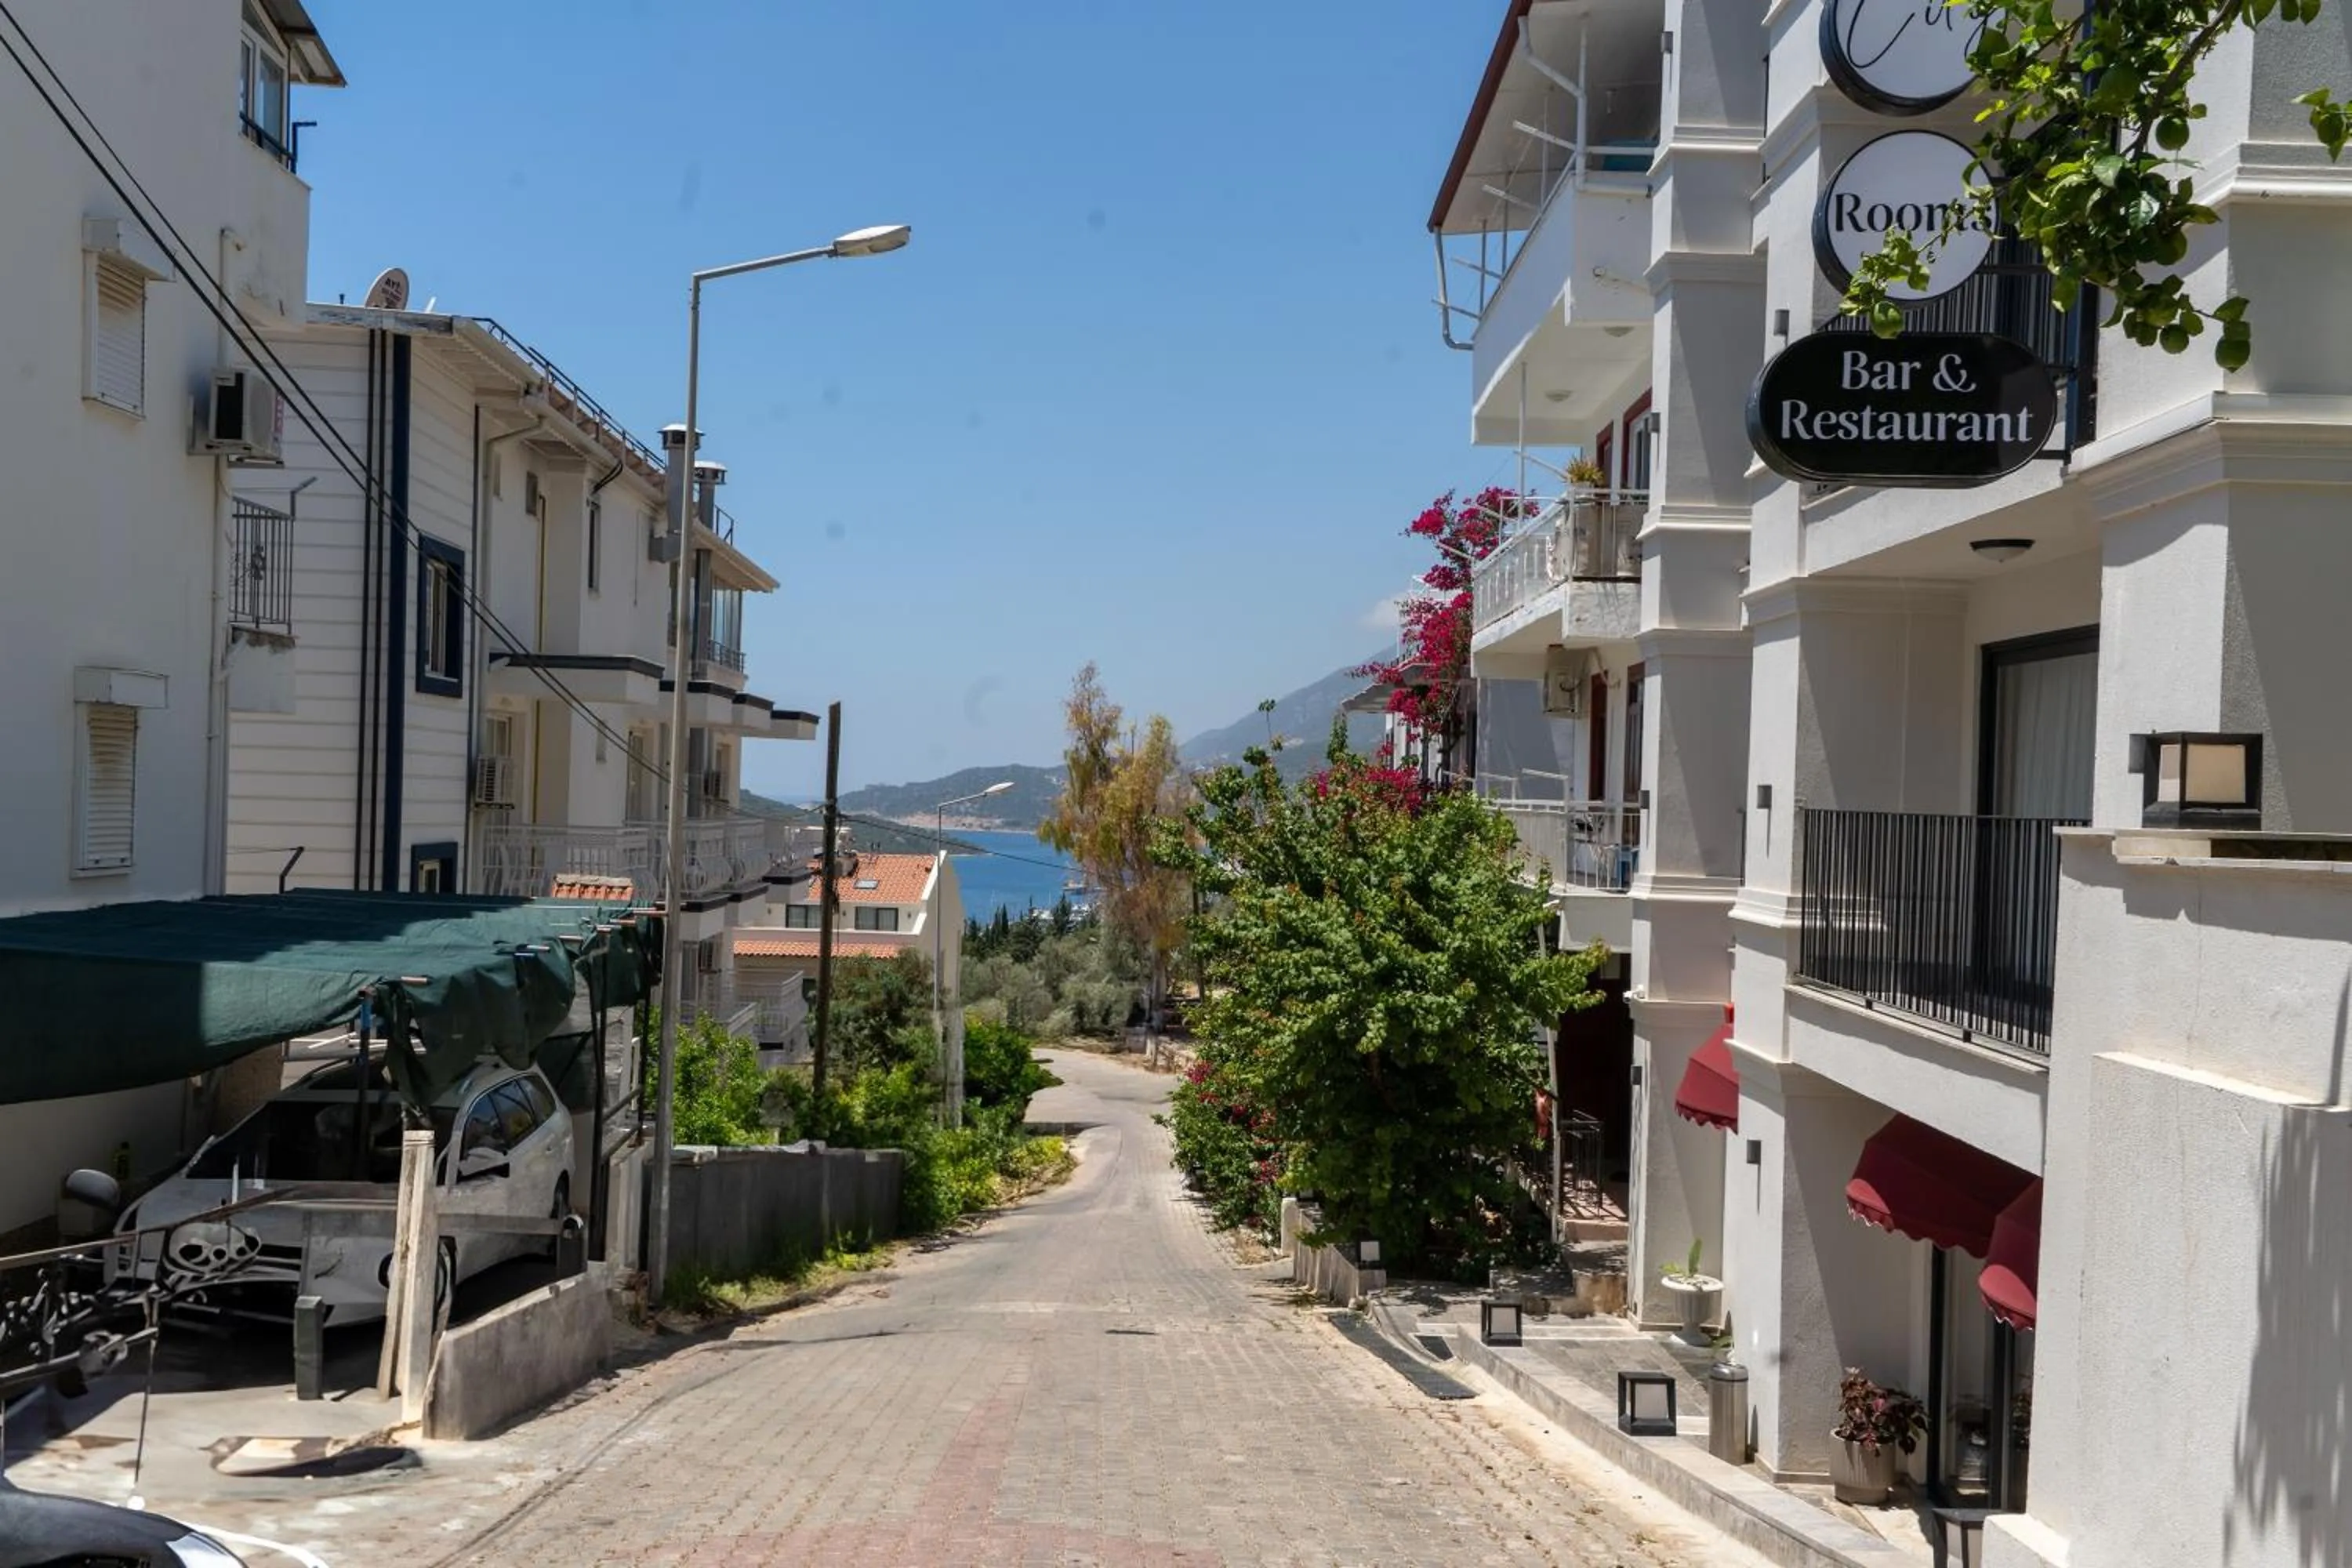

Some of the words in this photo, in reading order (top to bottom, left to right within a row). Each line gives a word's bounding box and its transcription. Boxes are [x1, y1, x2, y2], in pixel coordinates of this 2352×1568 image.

[1842, 350, 1921, 390] Bar
[1933, 354, 1976, 392] &
[1781, 399, 2033, 443] Restaurant
